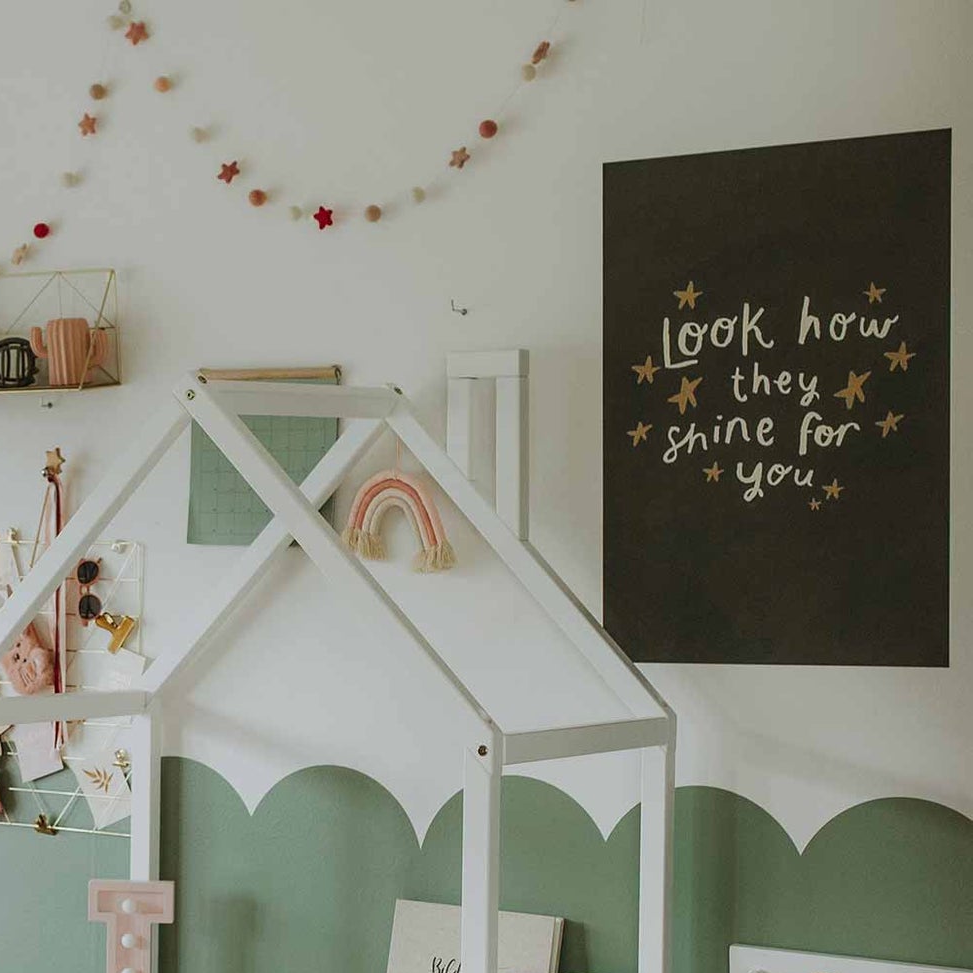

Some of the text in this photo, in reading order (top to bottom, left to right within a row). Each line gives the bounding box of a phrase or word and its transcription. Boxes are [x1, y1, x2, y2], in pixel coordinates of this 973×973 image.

[662, 295, 899, 369] Look how
[731, 361, 820, 407] they
[662, 411, 861, 464] shine for
[736, 461, 814, 502] you
